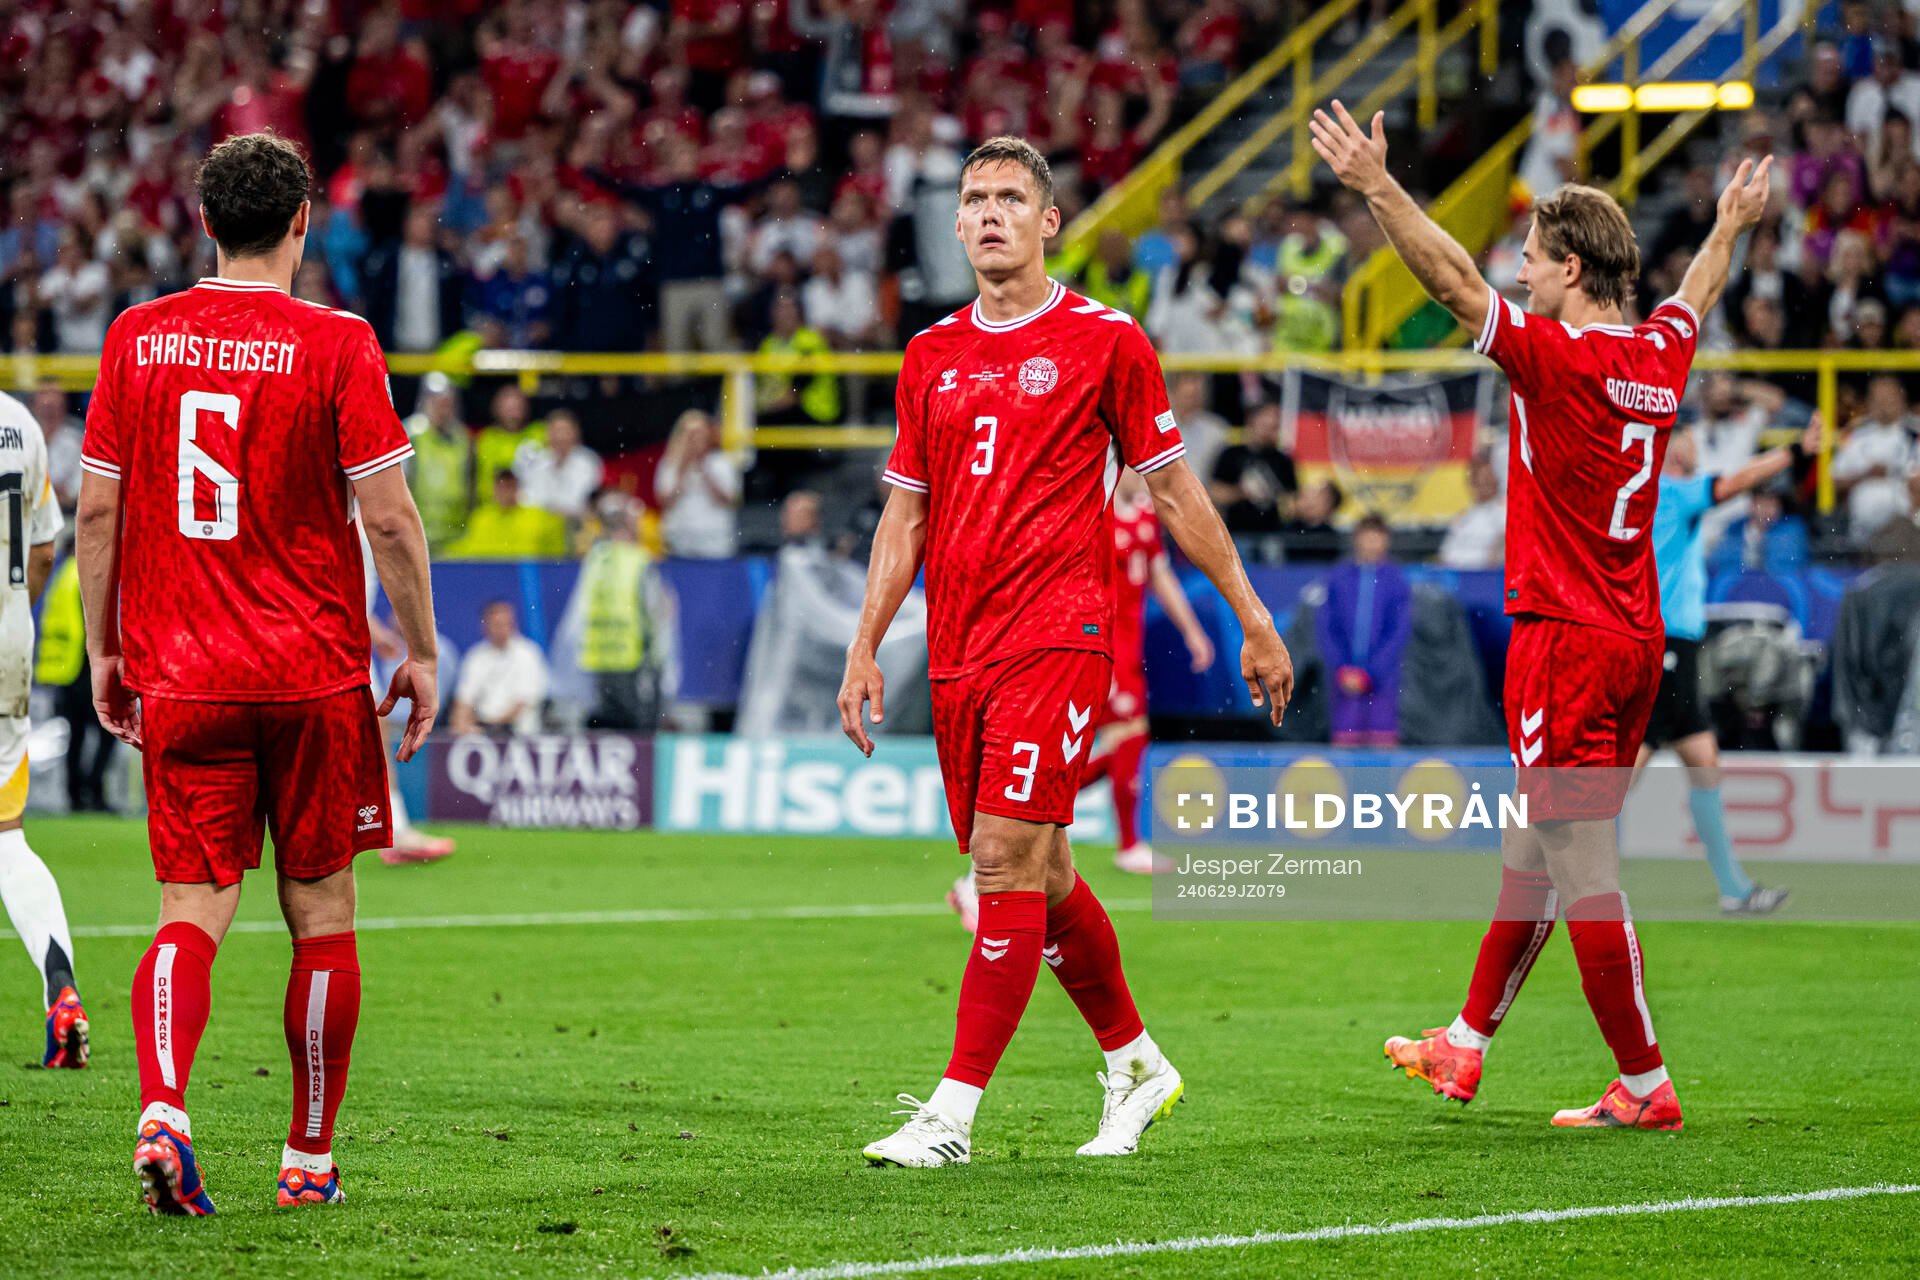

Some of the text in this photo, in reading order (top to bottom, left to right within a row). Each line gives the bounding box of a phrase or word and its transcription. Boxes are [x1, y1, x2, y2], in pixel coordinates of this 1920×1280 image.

[136, 333, 295, 375] CHRISTENSEN
[1606, 377, 1678, 414] ANDERSEN
[177, 389, 241, 541] 6
[970, 415, 999, 476] 3
[1607, 421, 1657, 541] 2
[446, 733, 639, 804] QATAR
[1003, 741, 1041, 803] 3
[157, 976, 169, 1051] DANMARK
[309, 1030, 322, 1103] DANMARK
